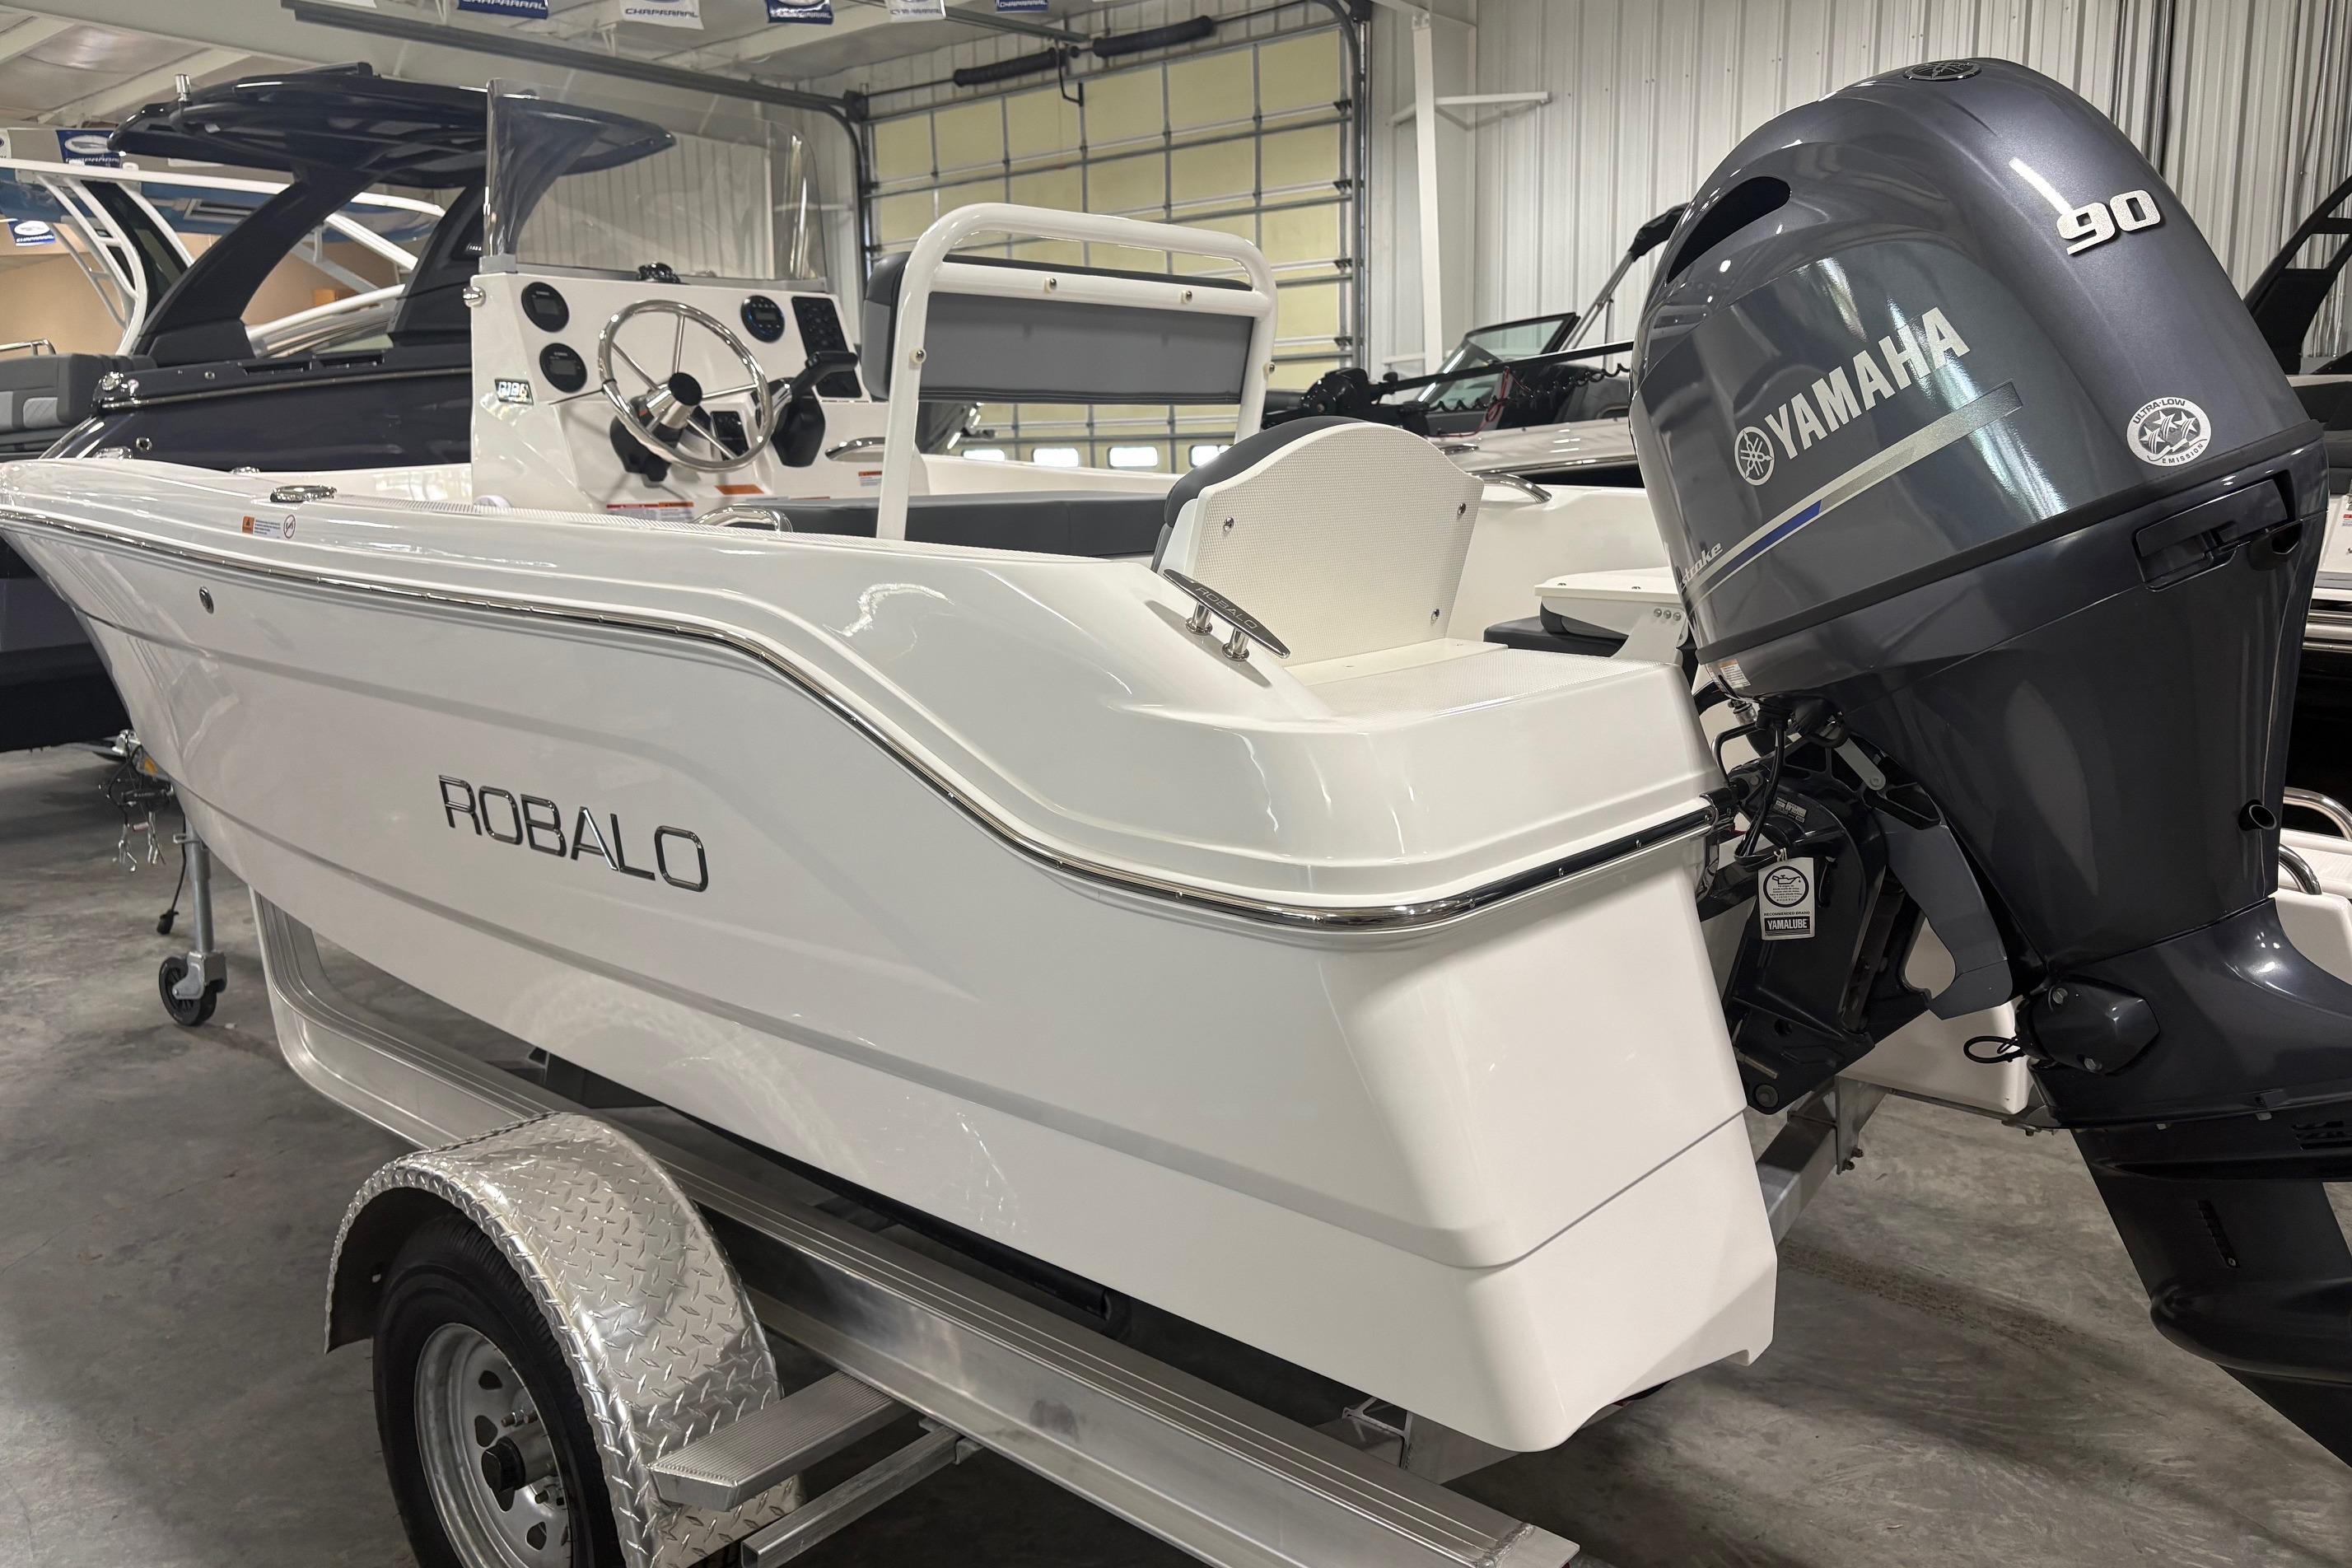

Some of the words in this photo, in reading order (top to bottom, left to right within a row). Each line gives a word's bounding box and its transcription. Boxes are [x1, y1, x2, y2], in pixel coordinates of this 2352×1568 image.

[625, 8, 699, 18] CHAPARRAL
[2056, 189, 2161, 255] 90
[1764, 307, 1970, 460] YAMAHA
[2162, 443, 2204, 464] EMISSION
[1195, 587, 1258, 629] ROBALO
[439, 775, 708, 892] ROBALO
[1767, 918, 1808, 930] YAMALUBE
